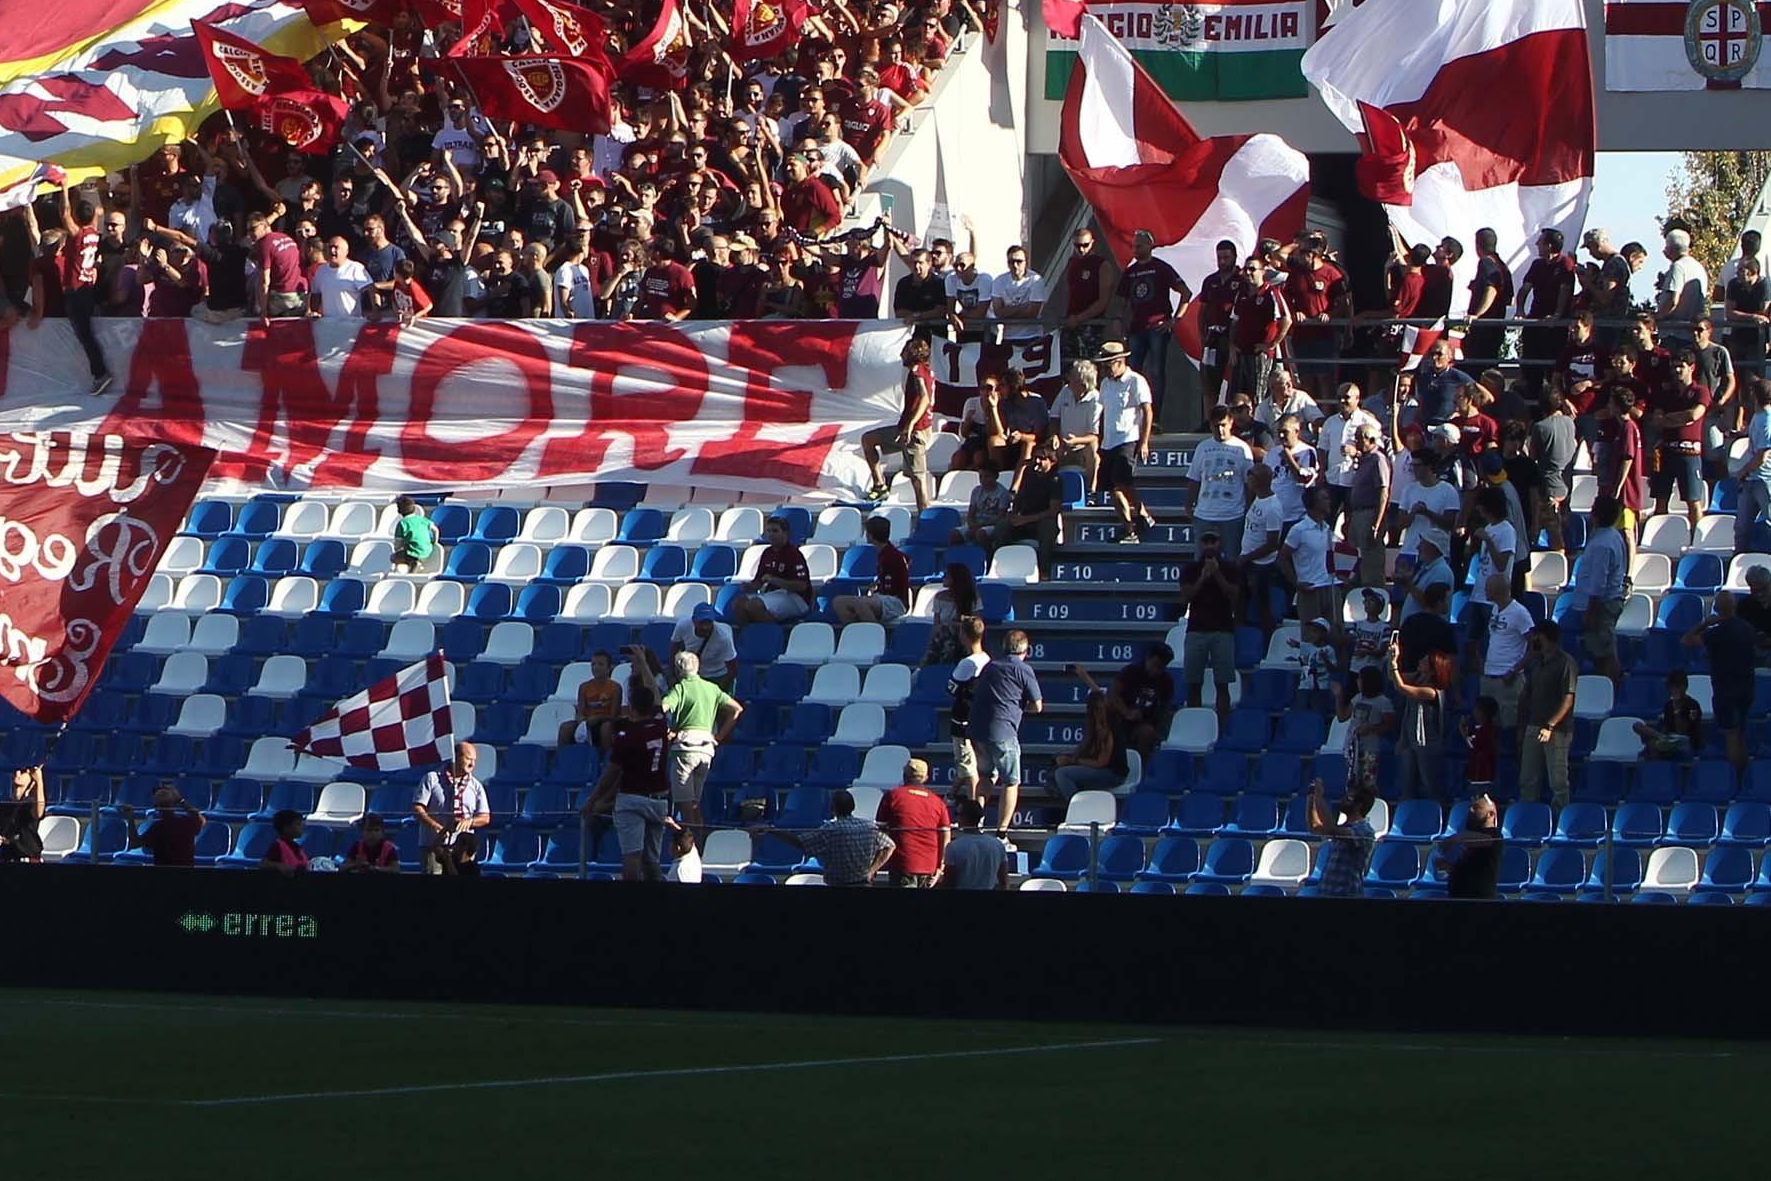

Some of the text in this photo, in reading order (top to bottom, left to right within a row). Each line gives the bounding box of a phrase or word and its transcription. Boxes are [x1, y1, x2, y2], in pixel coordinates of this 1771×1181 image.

[1204, 12, 1299, 40] EMILIA
[1706, 11, 1741, 28] S P
[1705, 44, 1741, 61] Q R
[104, 318, 859, 488] AMORE
[1167, 452, 1191, 465] FIL
[1056, 566, 1092, 579] F 10
[1161, 567, 1180, 580] 10
[1034, 605, 1068, 618] F 09
[1137, 605, 1156, 619] 09
[1112, 646, 1132, 659] 08
[1063, 728, 1083, 742] 06
